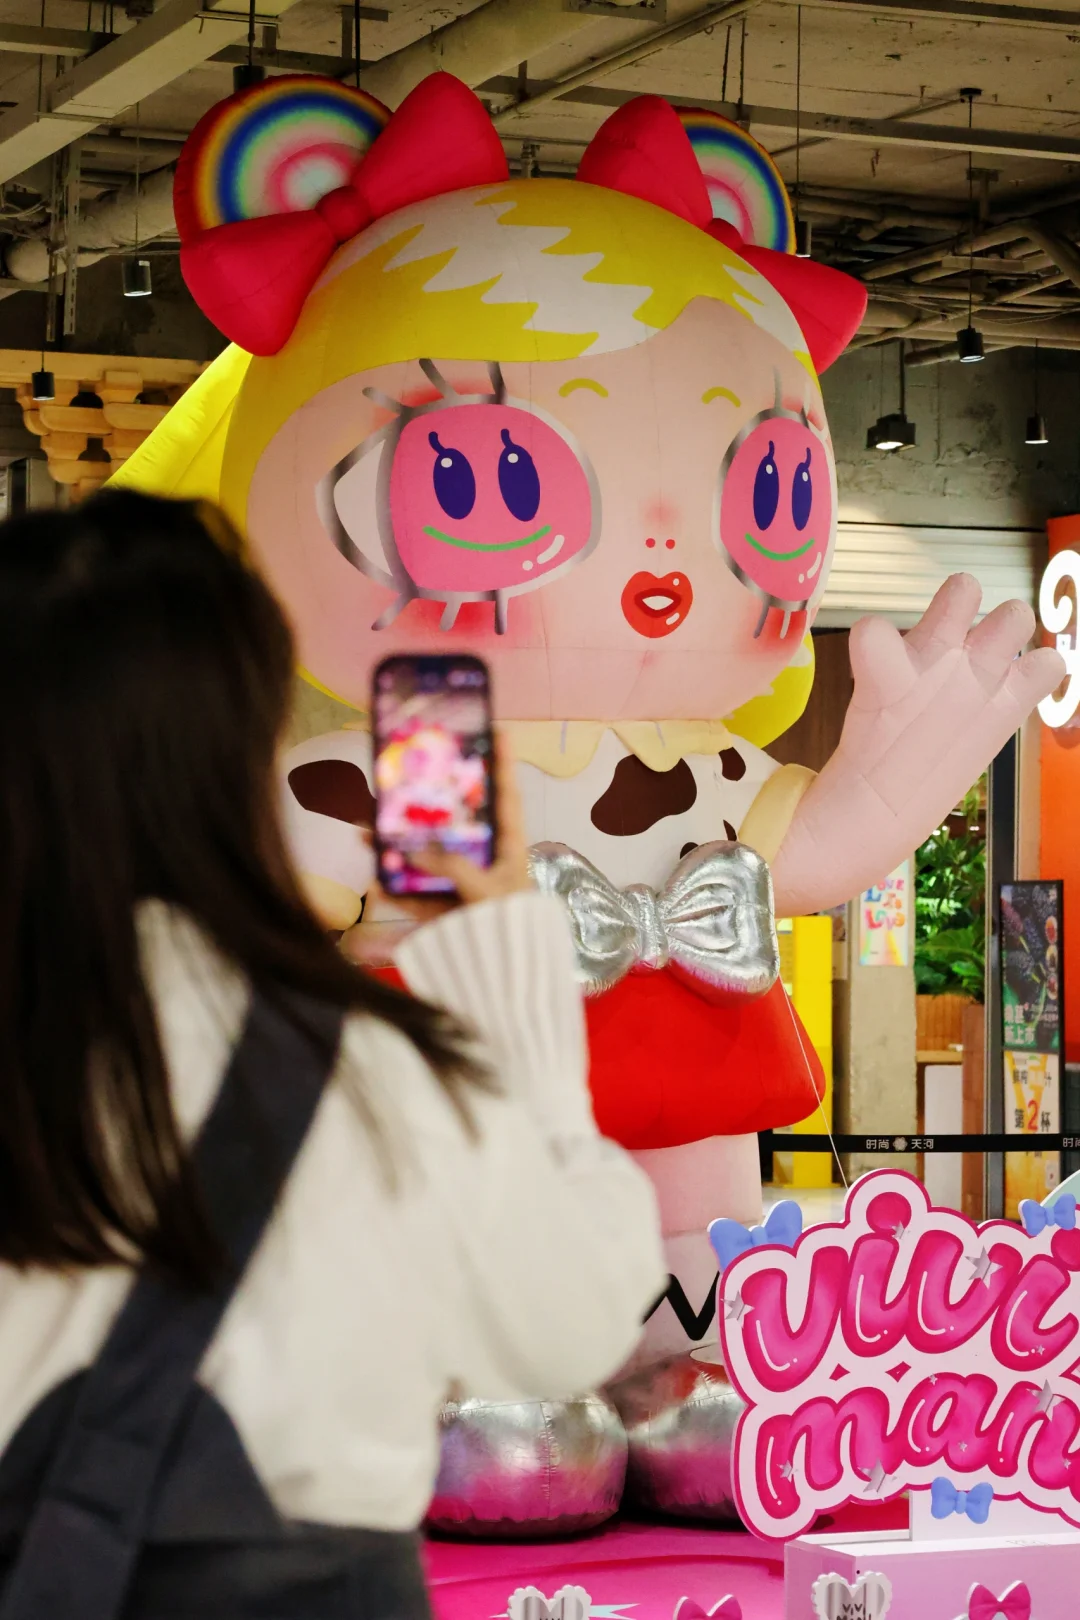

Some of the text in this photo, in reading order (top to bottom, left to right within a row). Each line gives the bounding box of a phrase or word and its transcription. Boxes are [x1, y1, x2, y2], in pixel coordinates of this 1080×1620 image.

[866, 1139, 934, 1150] 时尚 天河
[755, 1371, 1080, 1520] man
